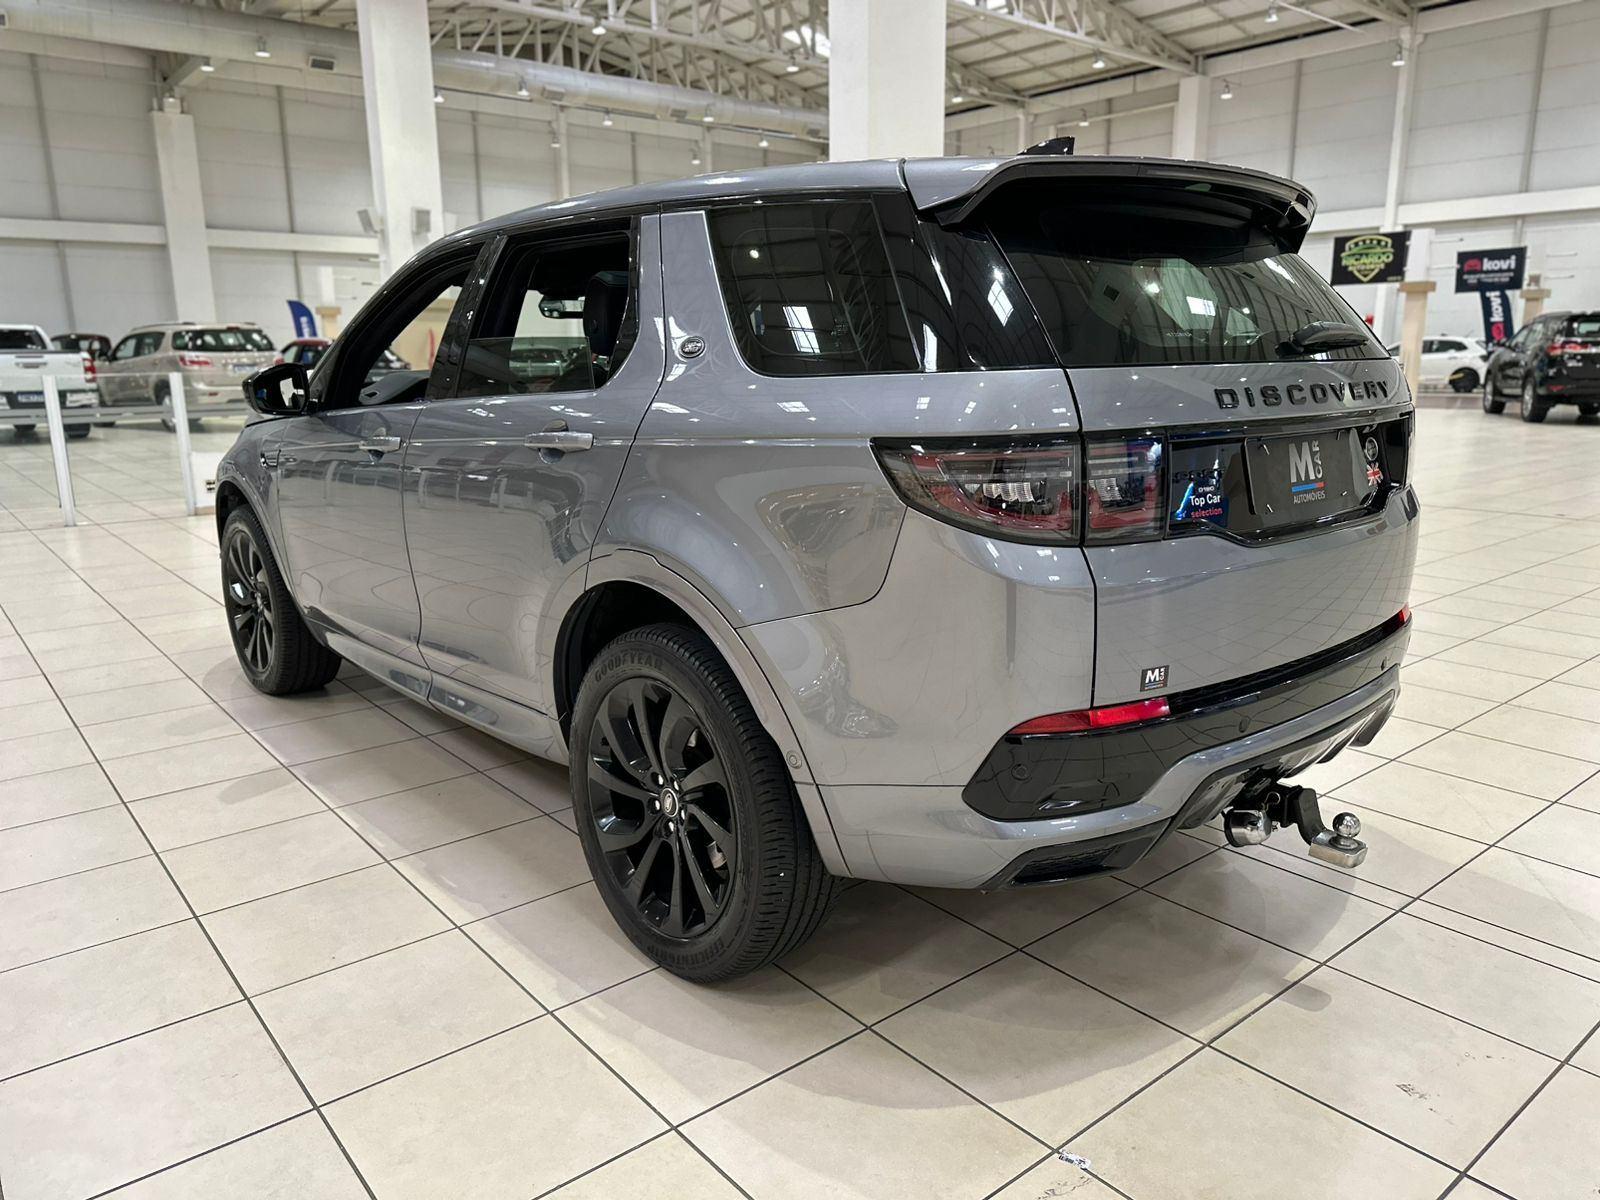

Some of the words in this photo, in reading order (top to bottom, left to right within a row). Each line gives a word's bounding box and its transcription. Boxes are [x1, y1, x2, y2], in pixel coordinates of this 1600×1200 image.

[1341, 252, 1394, 266] RICARDO
[1482, 254, 1517, 271] kovi
[1486, 291, 1505, 322] kovi
[1214, 381, 1388, 409] DISCOVERY
[1311, 440, 1323, 479] CAR
[1190, 495, 1205, 507] Top
[1206, 493, 1221, 504] Car
[1191, 507, 1223, 518] selection
